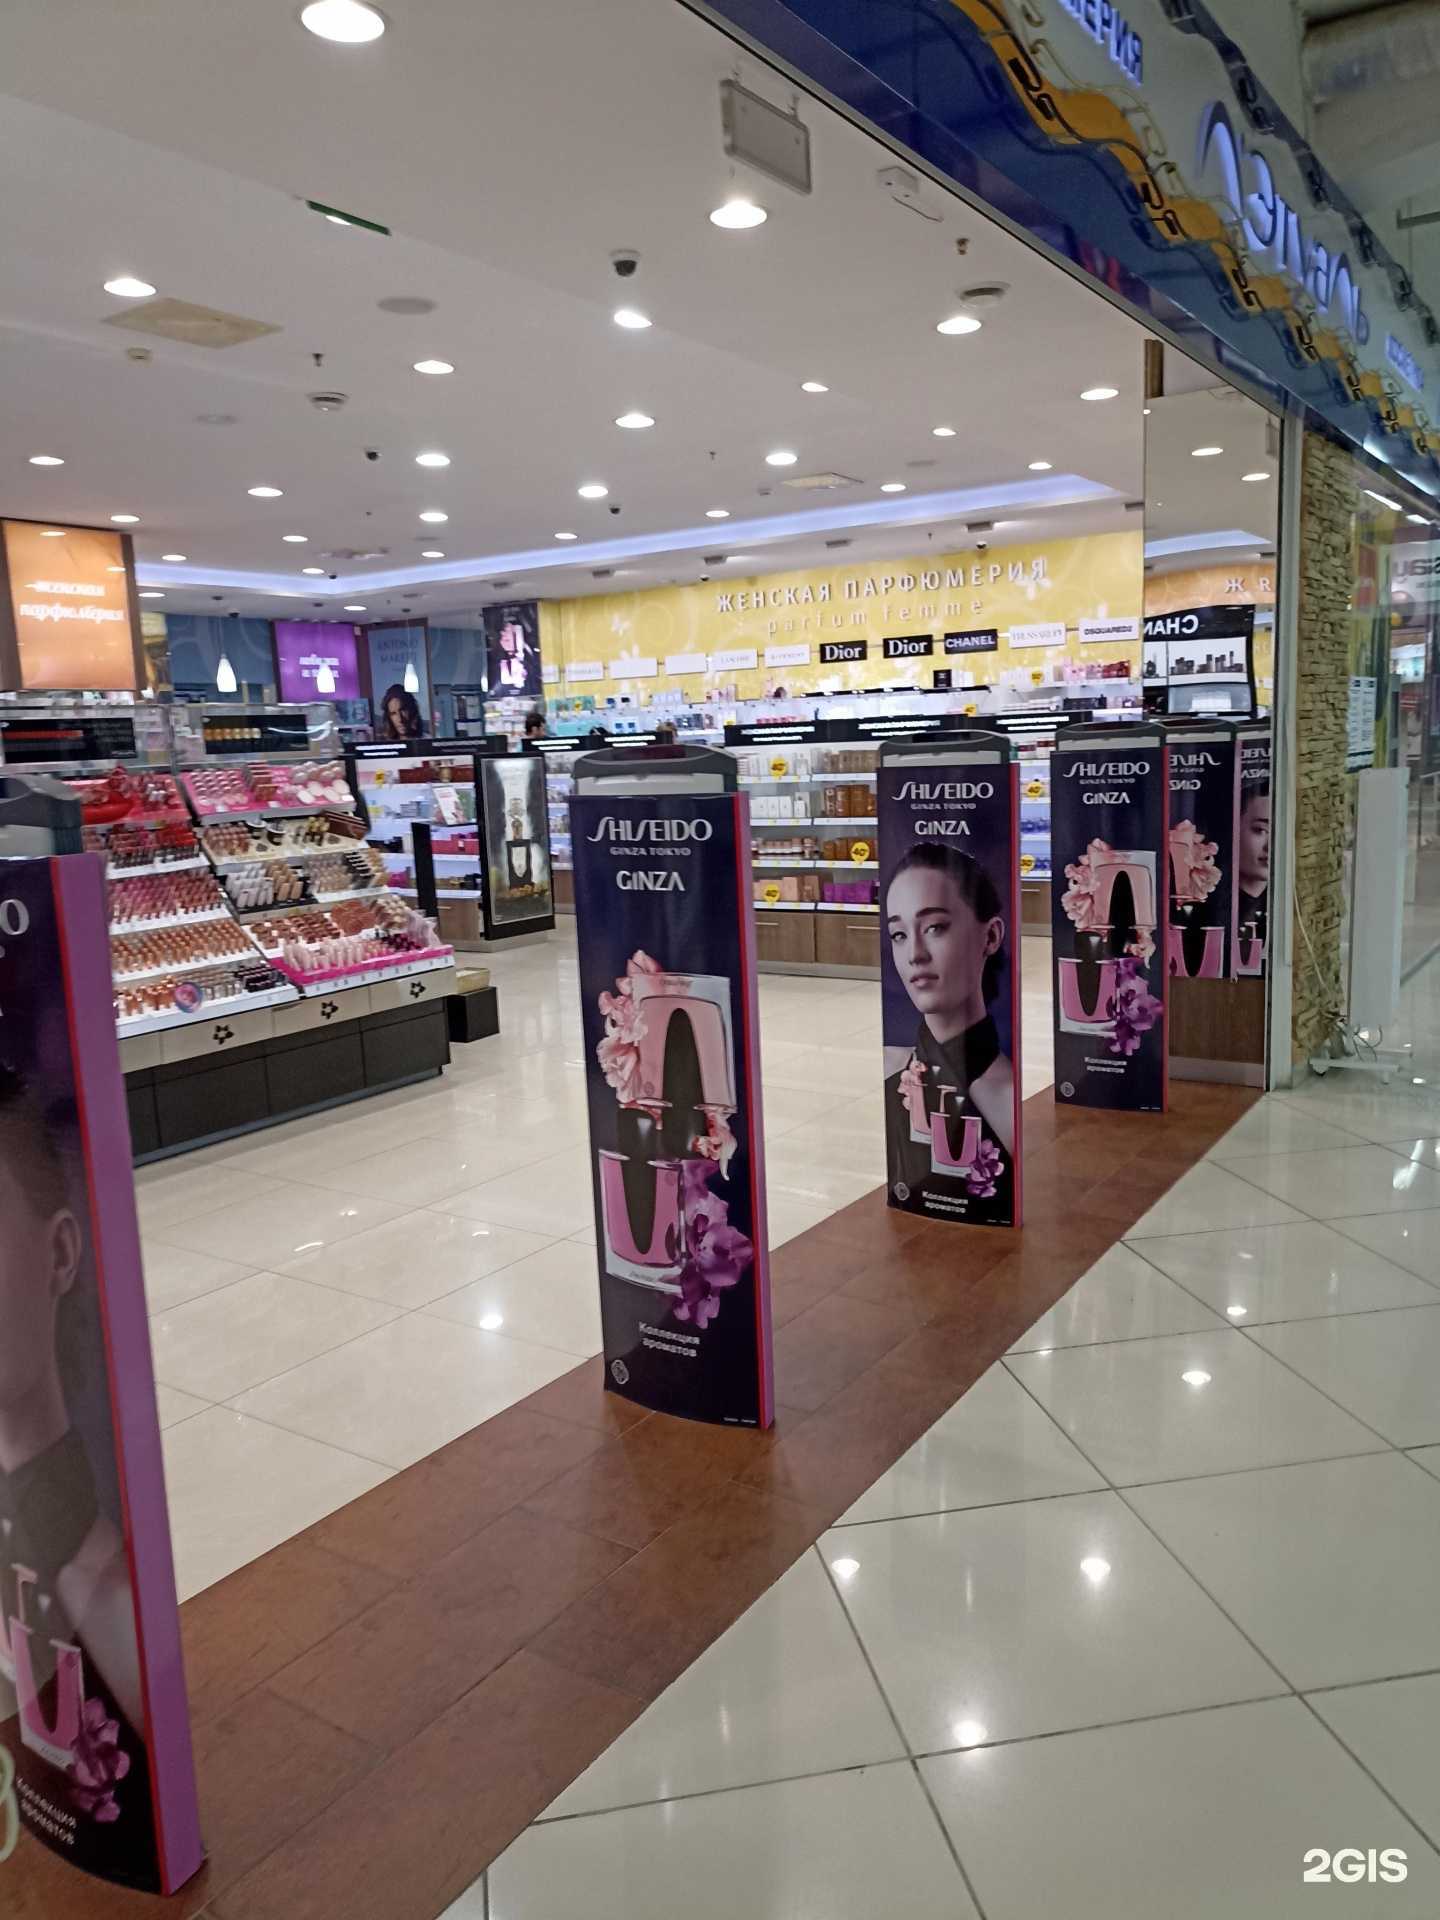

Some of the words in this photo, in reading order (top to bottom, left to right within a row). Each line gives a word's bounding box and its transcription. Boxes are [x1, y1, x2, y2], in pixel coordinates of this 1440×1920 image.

[719, 584, 832, 612] ЖЕНСКАЯ
[845, 557, 1047, 599] ПАРФЮМЕРИЯ
[887, 638, 929, 657] Dior
[945, 634, 995, 649] CHANEL
[824, 643, 863, 661] Dior
[1063, 761, 1150, 778] SHISEIDO
[891, 781, 995, 801] SHISEIDO
[1082, 791, 1131, 805] GINZA
[587, 816, 713, 842] SHISEIDO
[914, 820, 971, 836] GINZA
[610, 847, 647, 856] GINZA
[650, 846, 692, 857] TOKYO
[616, 870, 686, 892] GINZA
